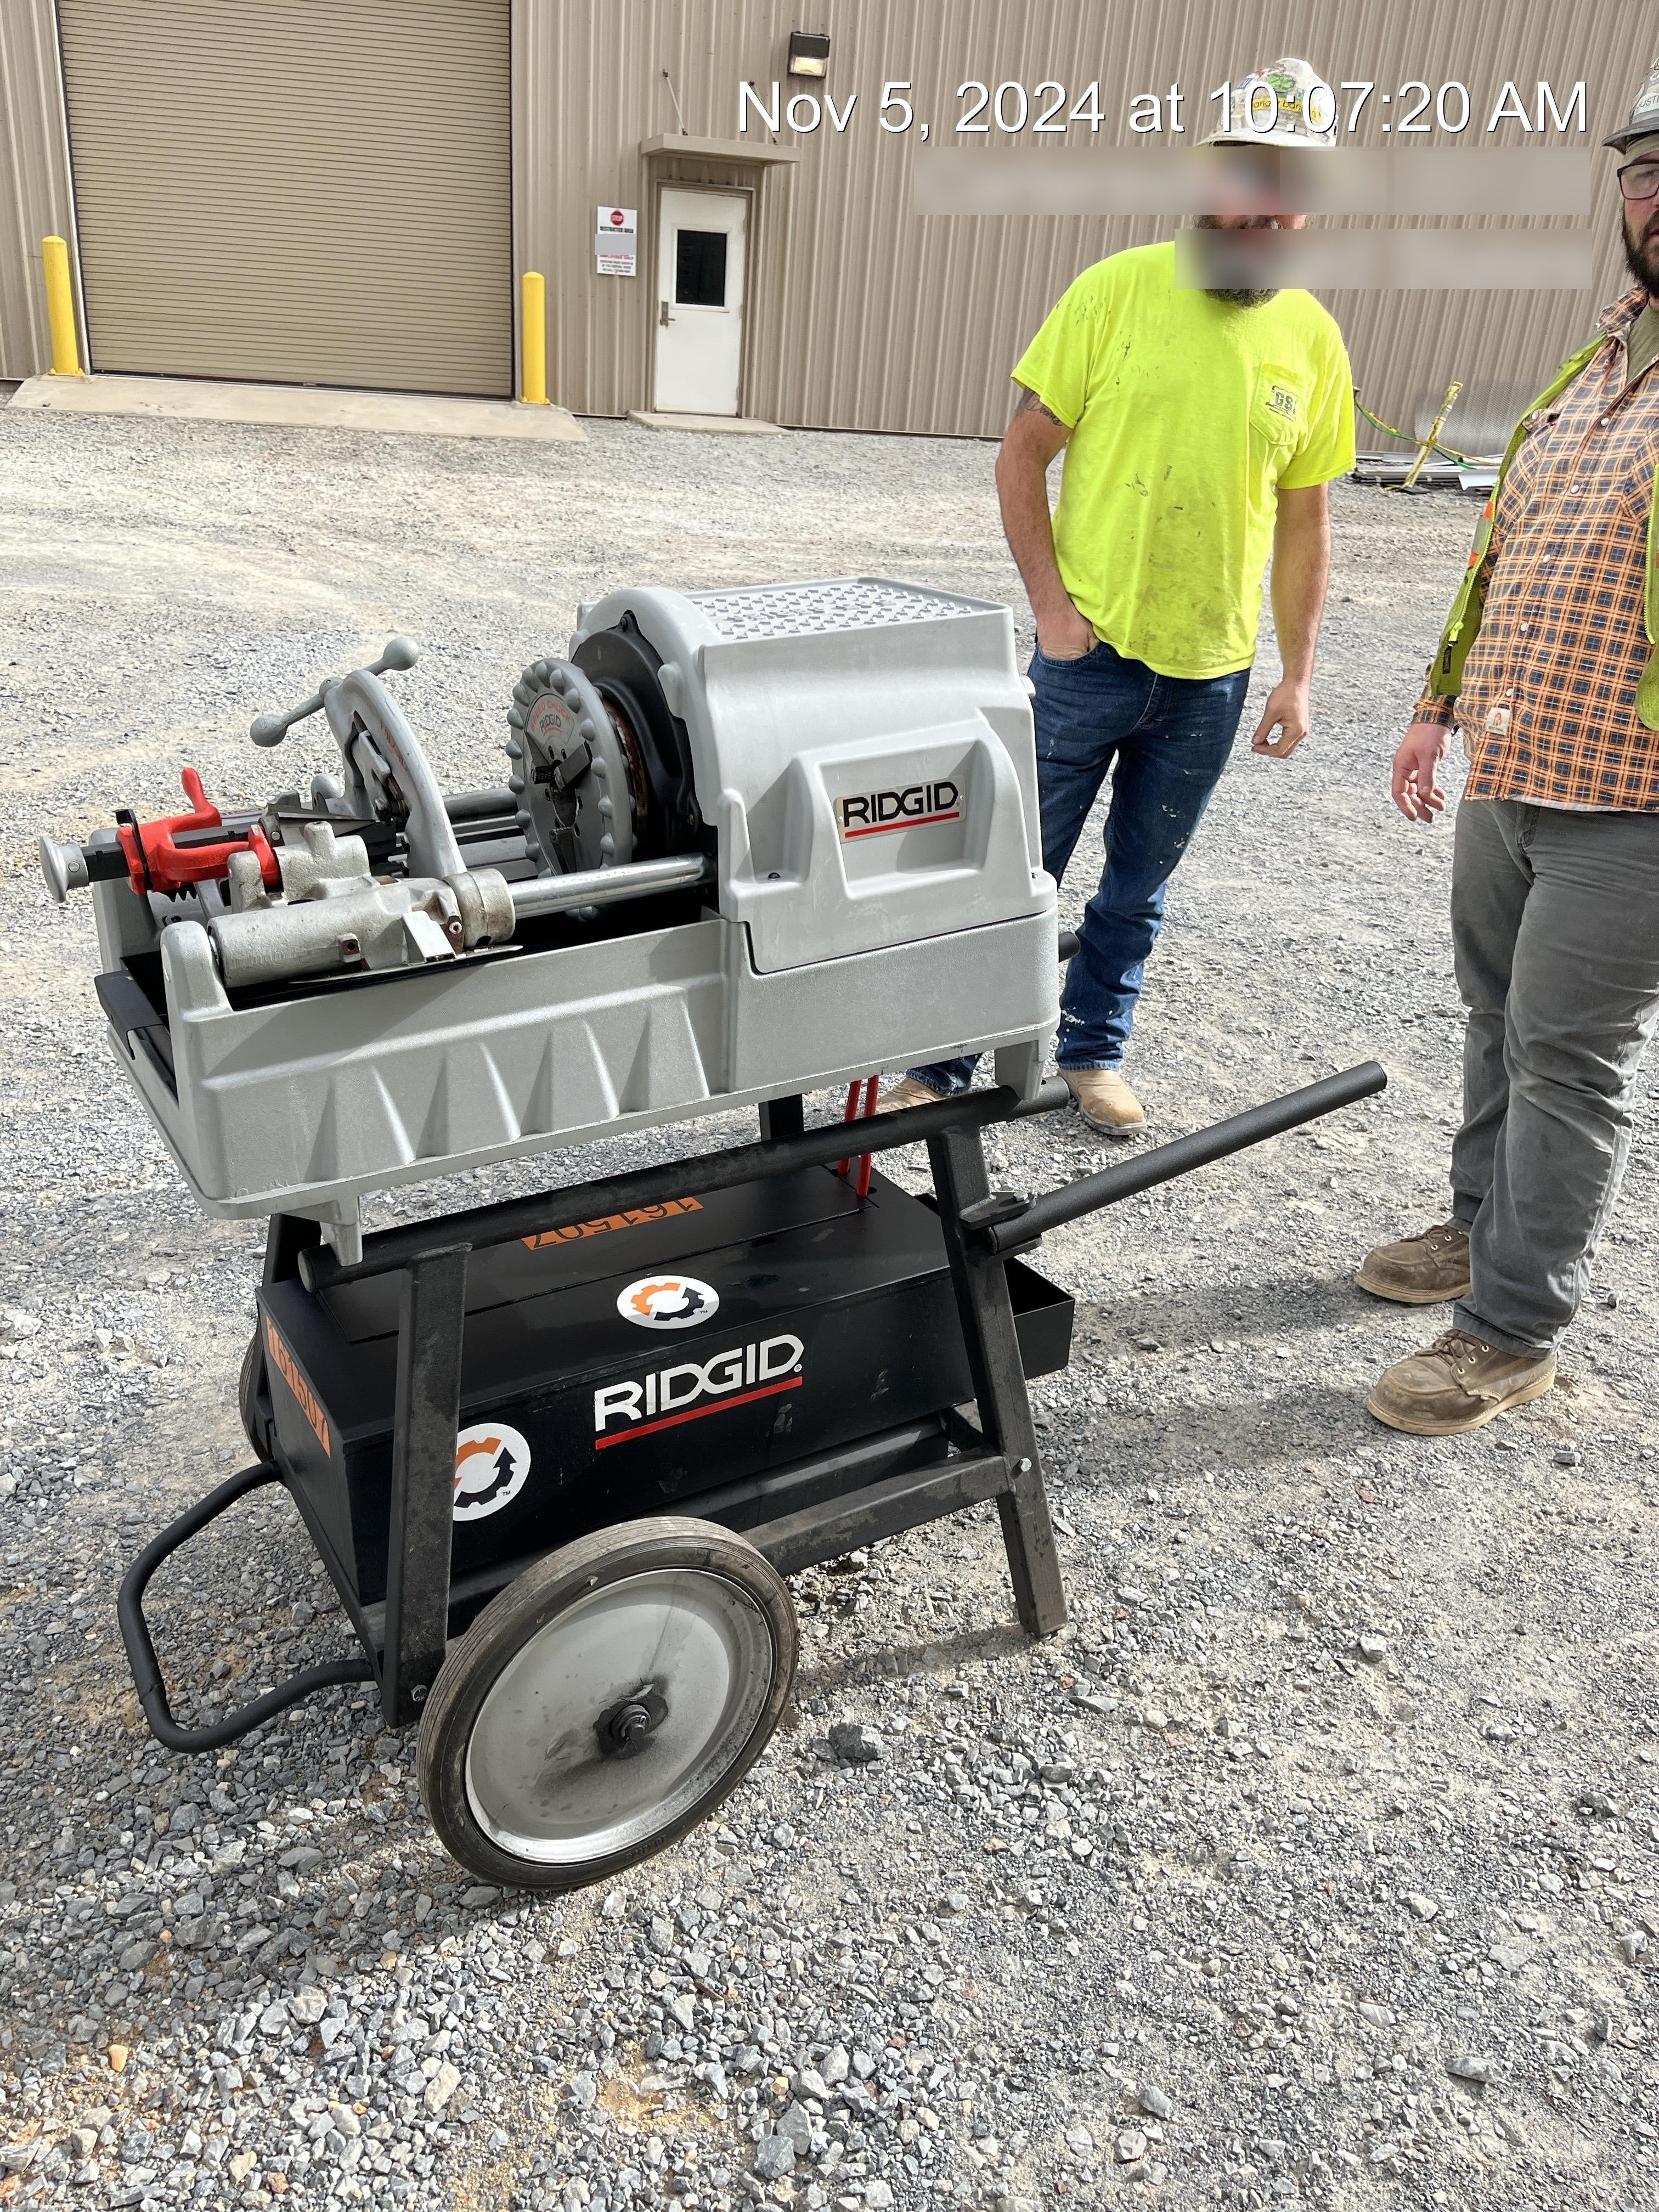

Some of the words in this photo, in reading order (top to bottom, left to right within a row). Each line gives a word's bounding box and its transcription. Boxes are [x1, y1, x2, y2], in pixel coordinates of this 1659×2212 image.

[531, 702, 545, 733] SPEED
[547, 699, 571, 724] CHUCK
[539, 714, 562, 733] RIDGID
[843, 781, 959, 827] RIDGID
[594, 1334, 804, 1432] RIDGID
